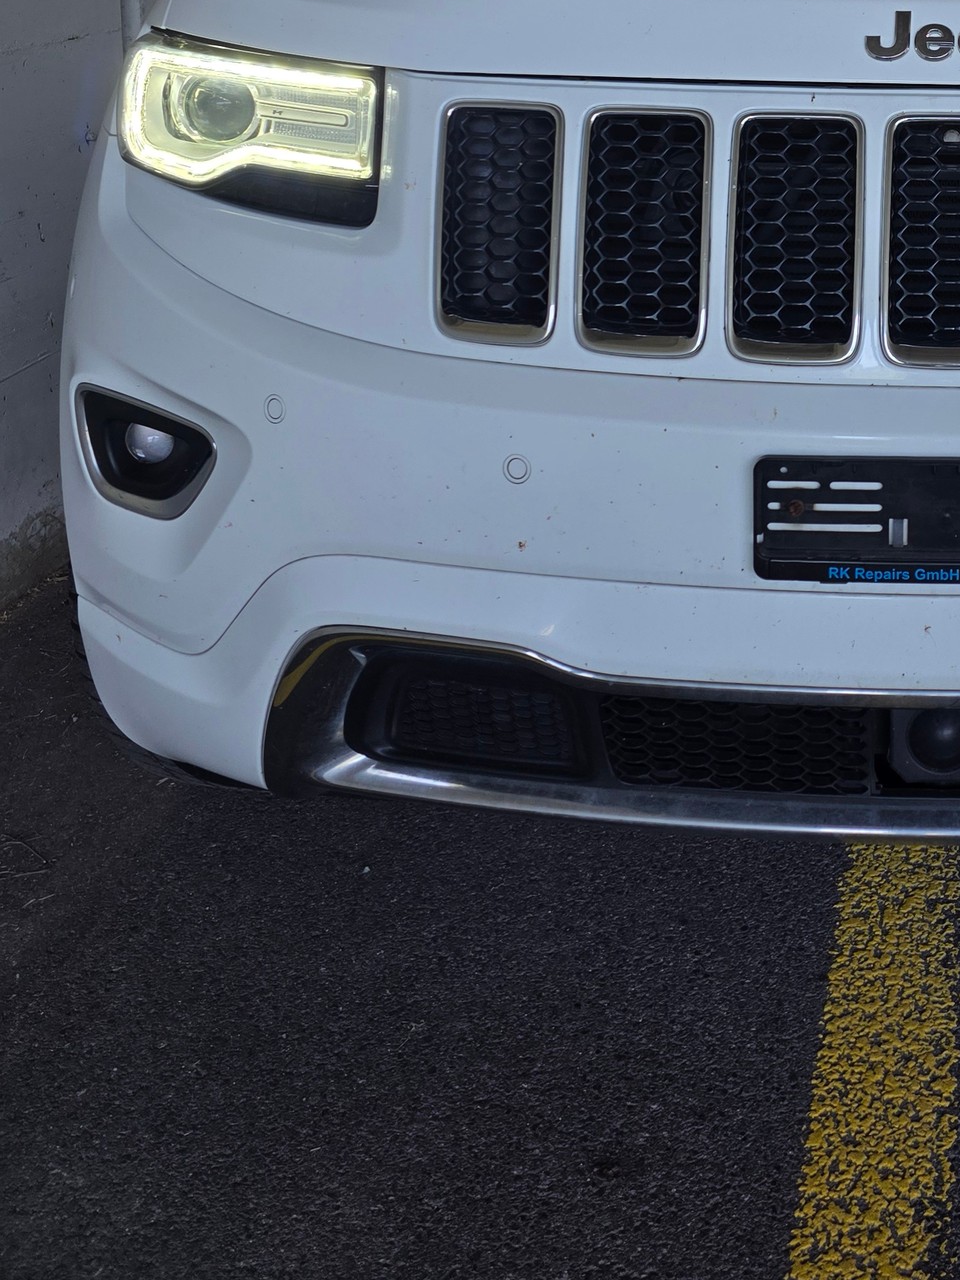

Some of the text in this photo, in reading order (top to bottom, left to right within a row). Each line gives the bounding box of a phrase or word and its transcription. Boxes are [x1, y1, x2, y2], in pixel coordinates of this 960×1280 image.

[828, 567, 850, 580] RK
[855, 567, 910, 583] Repairs
[914, 568, 960, 581] GmbH
